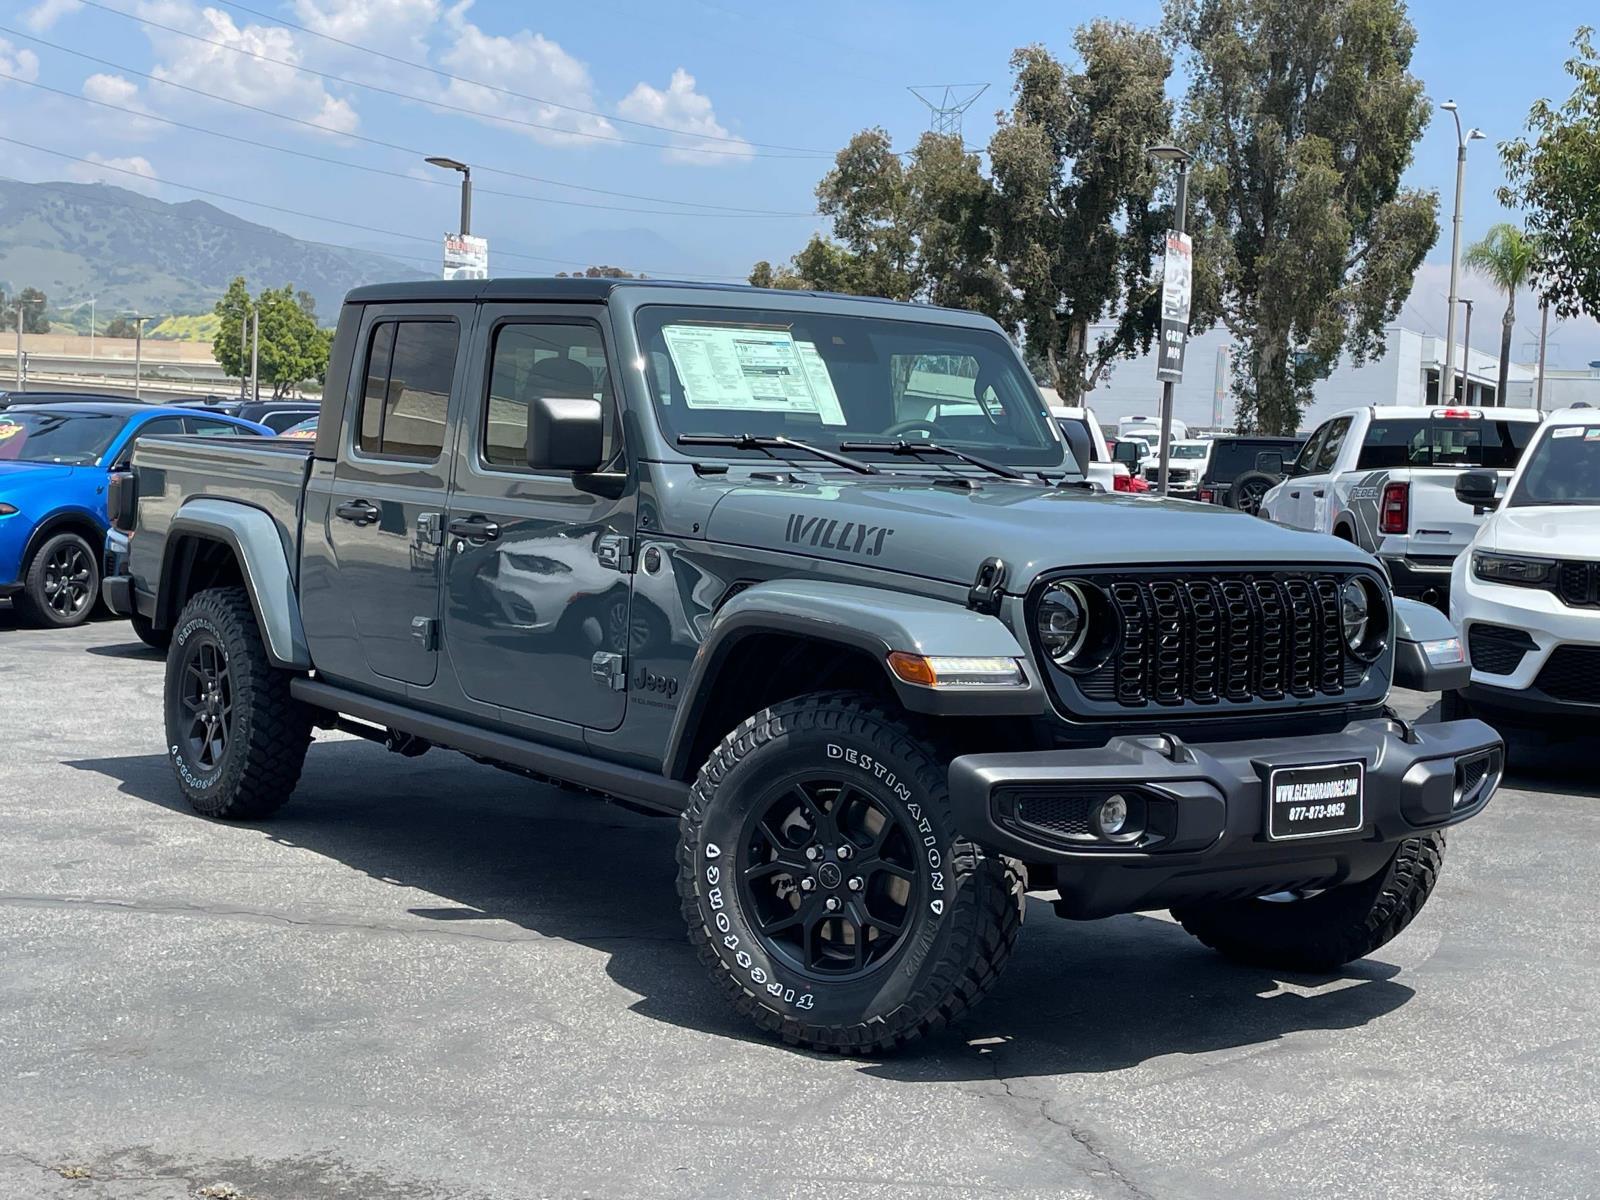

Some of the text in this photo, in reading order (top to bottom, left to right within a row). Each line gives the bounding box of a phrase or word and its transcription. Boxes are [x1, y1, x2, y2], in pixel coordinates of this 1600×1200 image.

[785, 513, 895, 556] WILLYS
[633, 667, 679, 699] Jeep
[827, 743, 944, 891] DESTINATION
[1289, 803, 1346, 821] 877-873-9952
